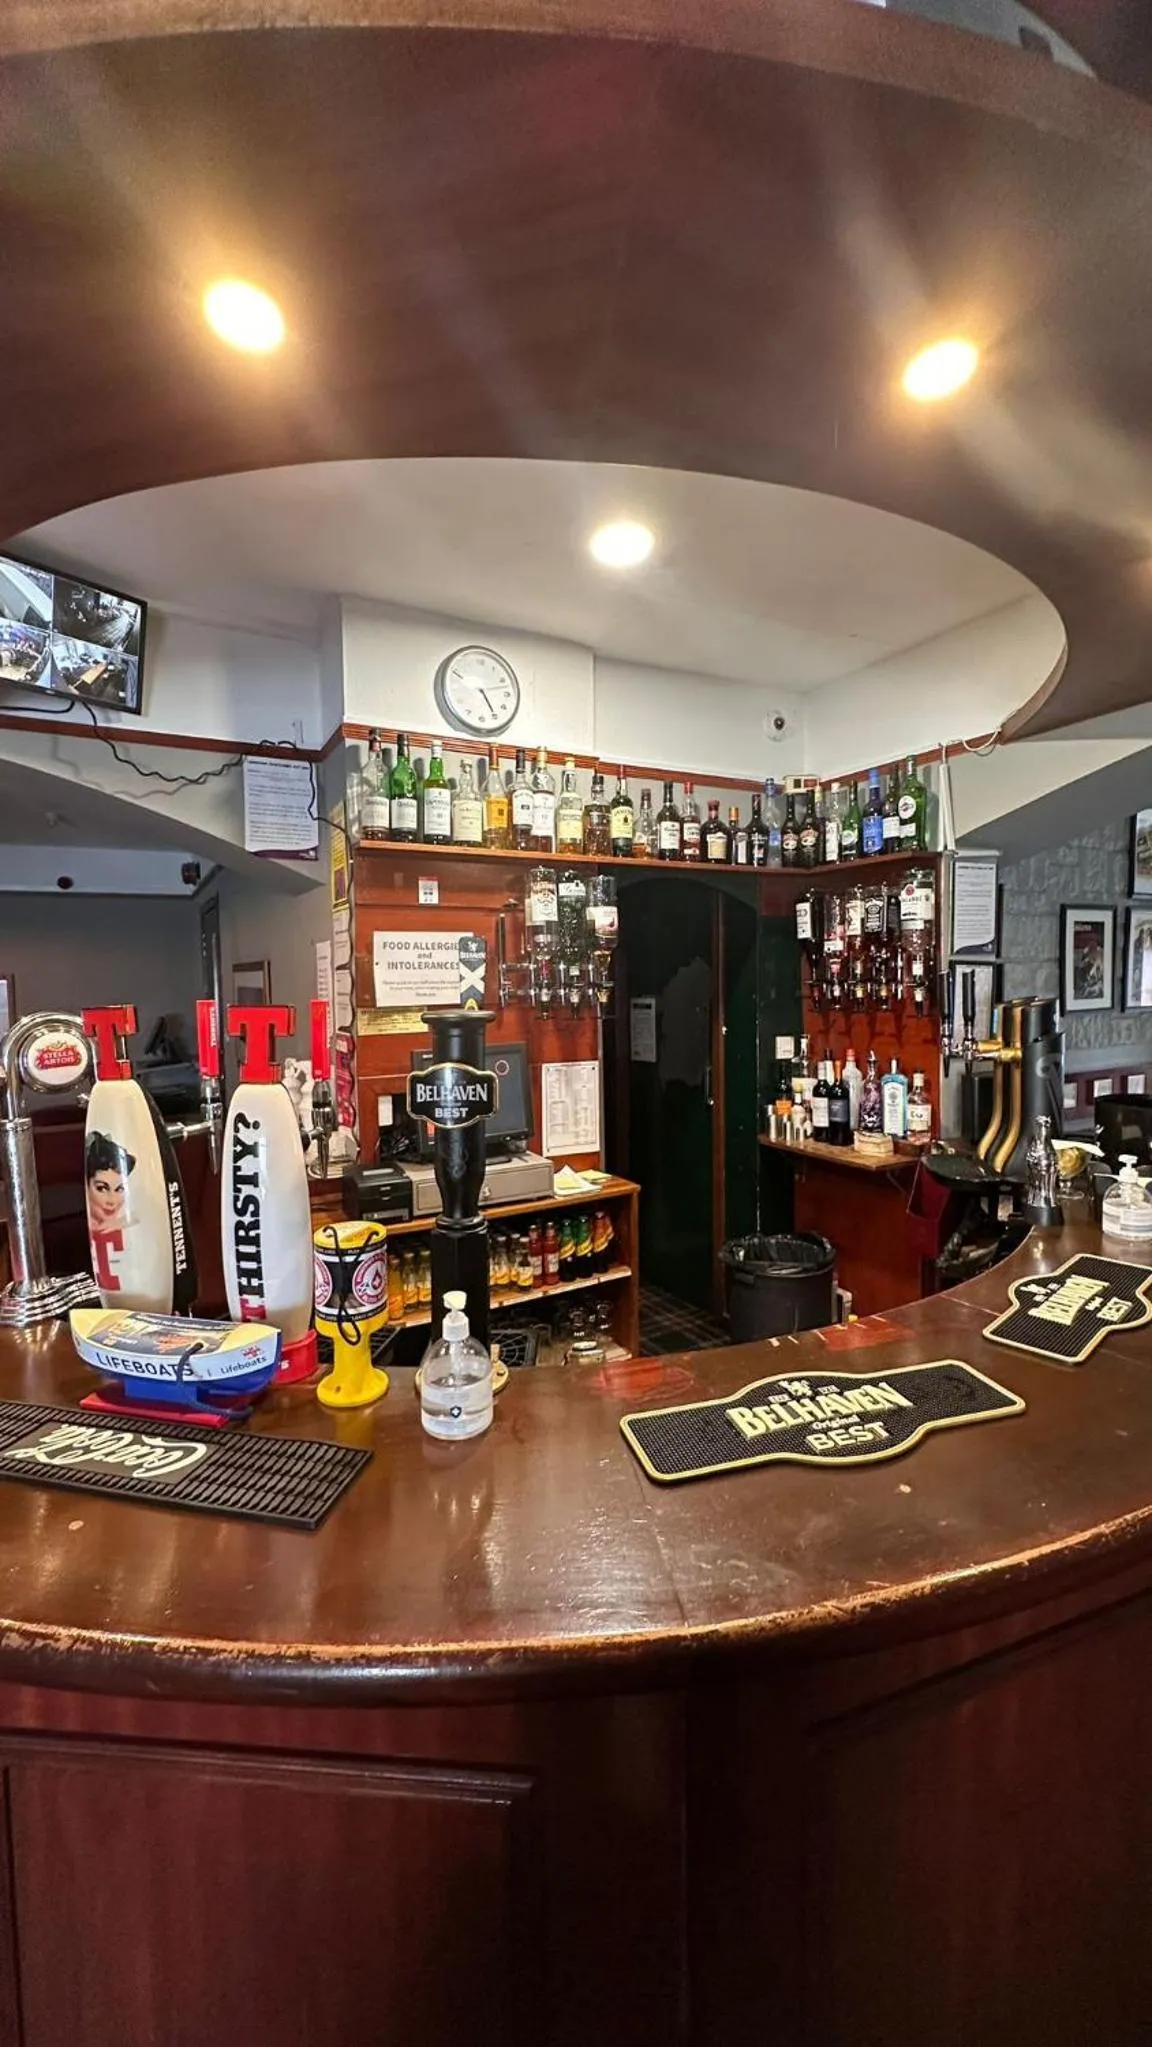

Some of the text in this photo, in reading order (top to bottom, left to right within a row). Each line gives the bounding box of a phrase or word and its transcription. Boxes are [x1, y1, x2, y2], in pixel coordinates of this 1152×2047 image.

[382, 941, 460, 951] FOOD ALLERGIE
[416, 952, 432, 960] and
[387, 961, 460, 971] INTOLERANCES
[81, 1004, 137, 1081] T
[227, 1004, 296, 1084] T
[43, 1050, 75, 1059] STELLA
[43, 1057, 75, 1066] ARTOIS
[416, 1083, 488, 1102] BELHAVEN
[435, 1107, 469, 1118] BEST
[232, 1112, 267, 1322] THIRSTY?
[168, 1182, 188, 1276] TENNENT'S
[96, 1352, 194, 1377] LIFEBOATS
[220, 1356, 267, 1376] Lifeboats
[726, 1382, 914, 1439] BELHAVEN
[812, 1414, 861, 1430] Original
[806, 1421, 890, 1451] BEST
